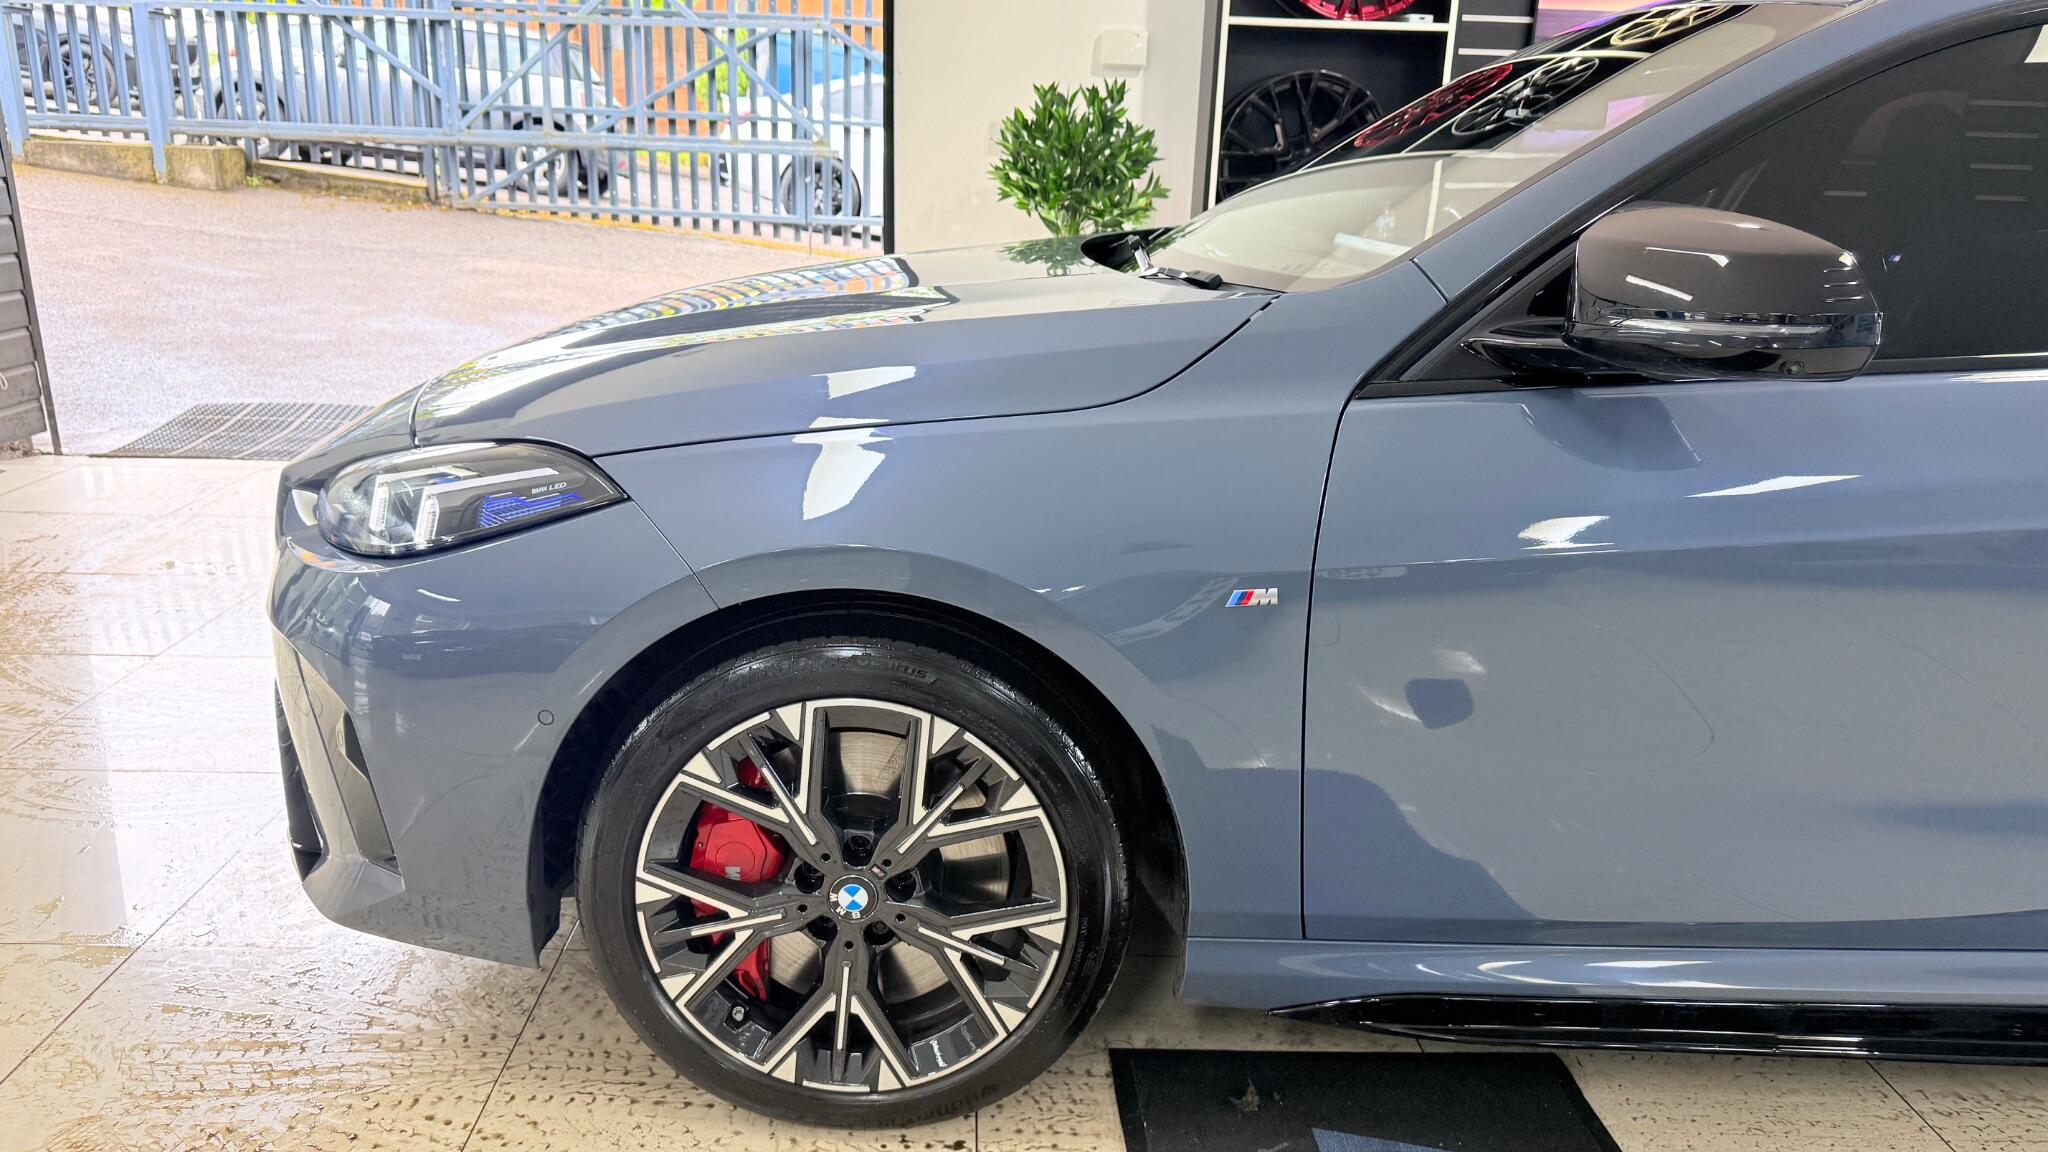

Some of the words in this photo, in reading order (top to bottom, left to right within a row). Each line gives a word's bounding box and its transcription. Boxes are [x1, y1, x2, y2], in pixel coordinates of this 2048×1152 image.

[531, 485, 548, 495] BMW
[548, 481, 568, 491] LED
[1246, 587, 1279, 607] M
